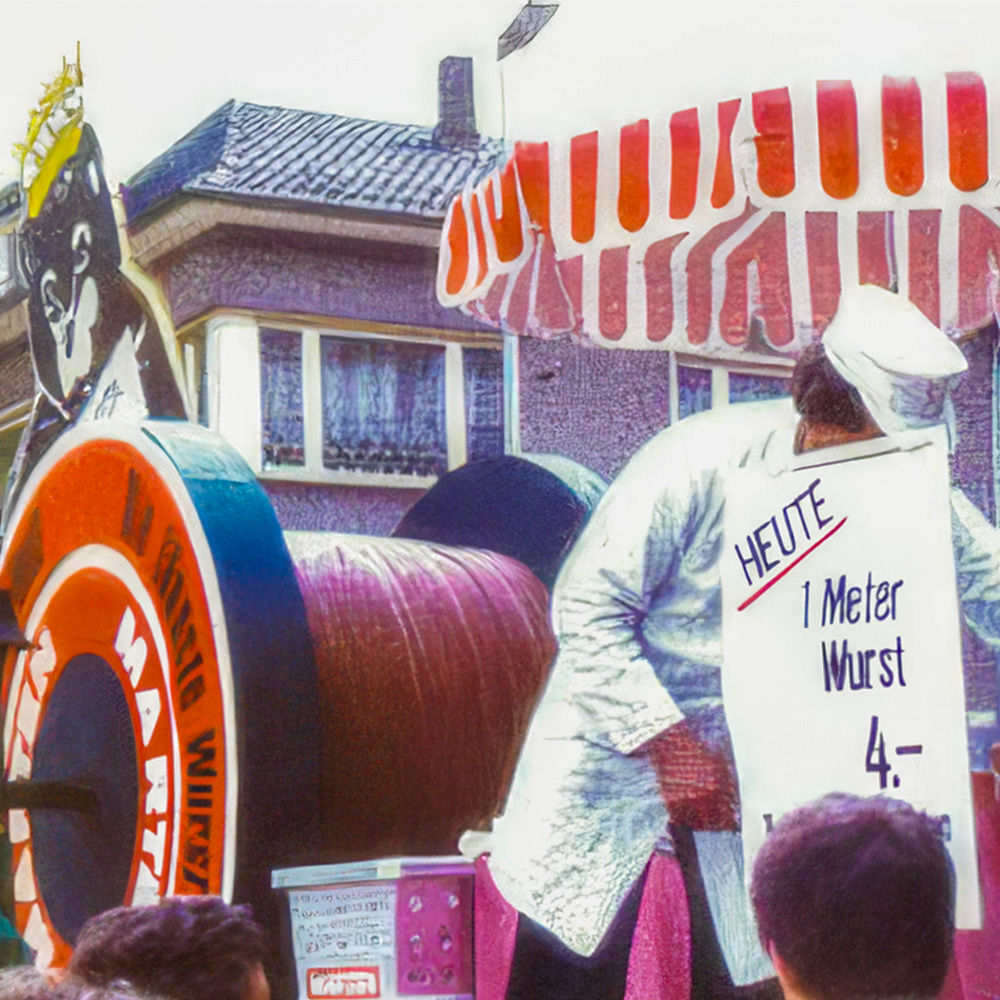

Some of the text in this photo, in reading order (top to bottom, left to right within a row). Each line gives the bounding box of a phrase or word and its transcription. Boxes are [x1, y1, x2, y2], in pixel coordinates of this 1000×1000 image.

[734, 478, 834, 586] HEUTE
[801, 571, 904, 628] 1 Meter
[821, 636, 906, 692] Wurst
